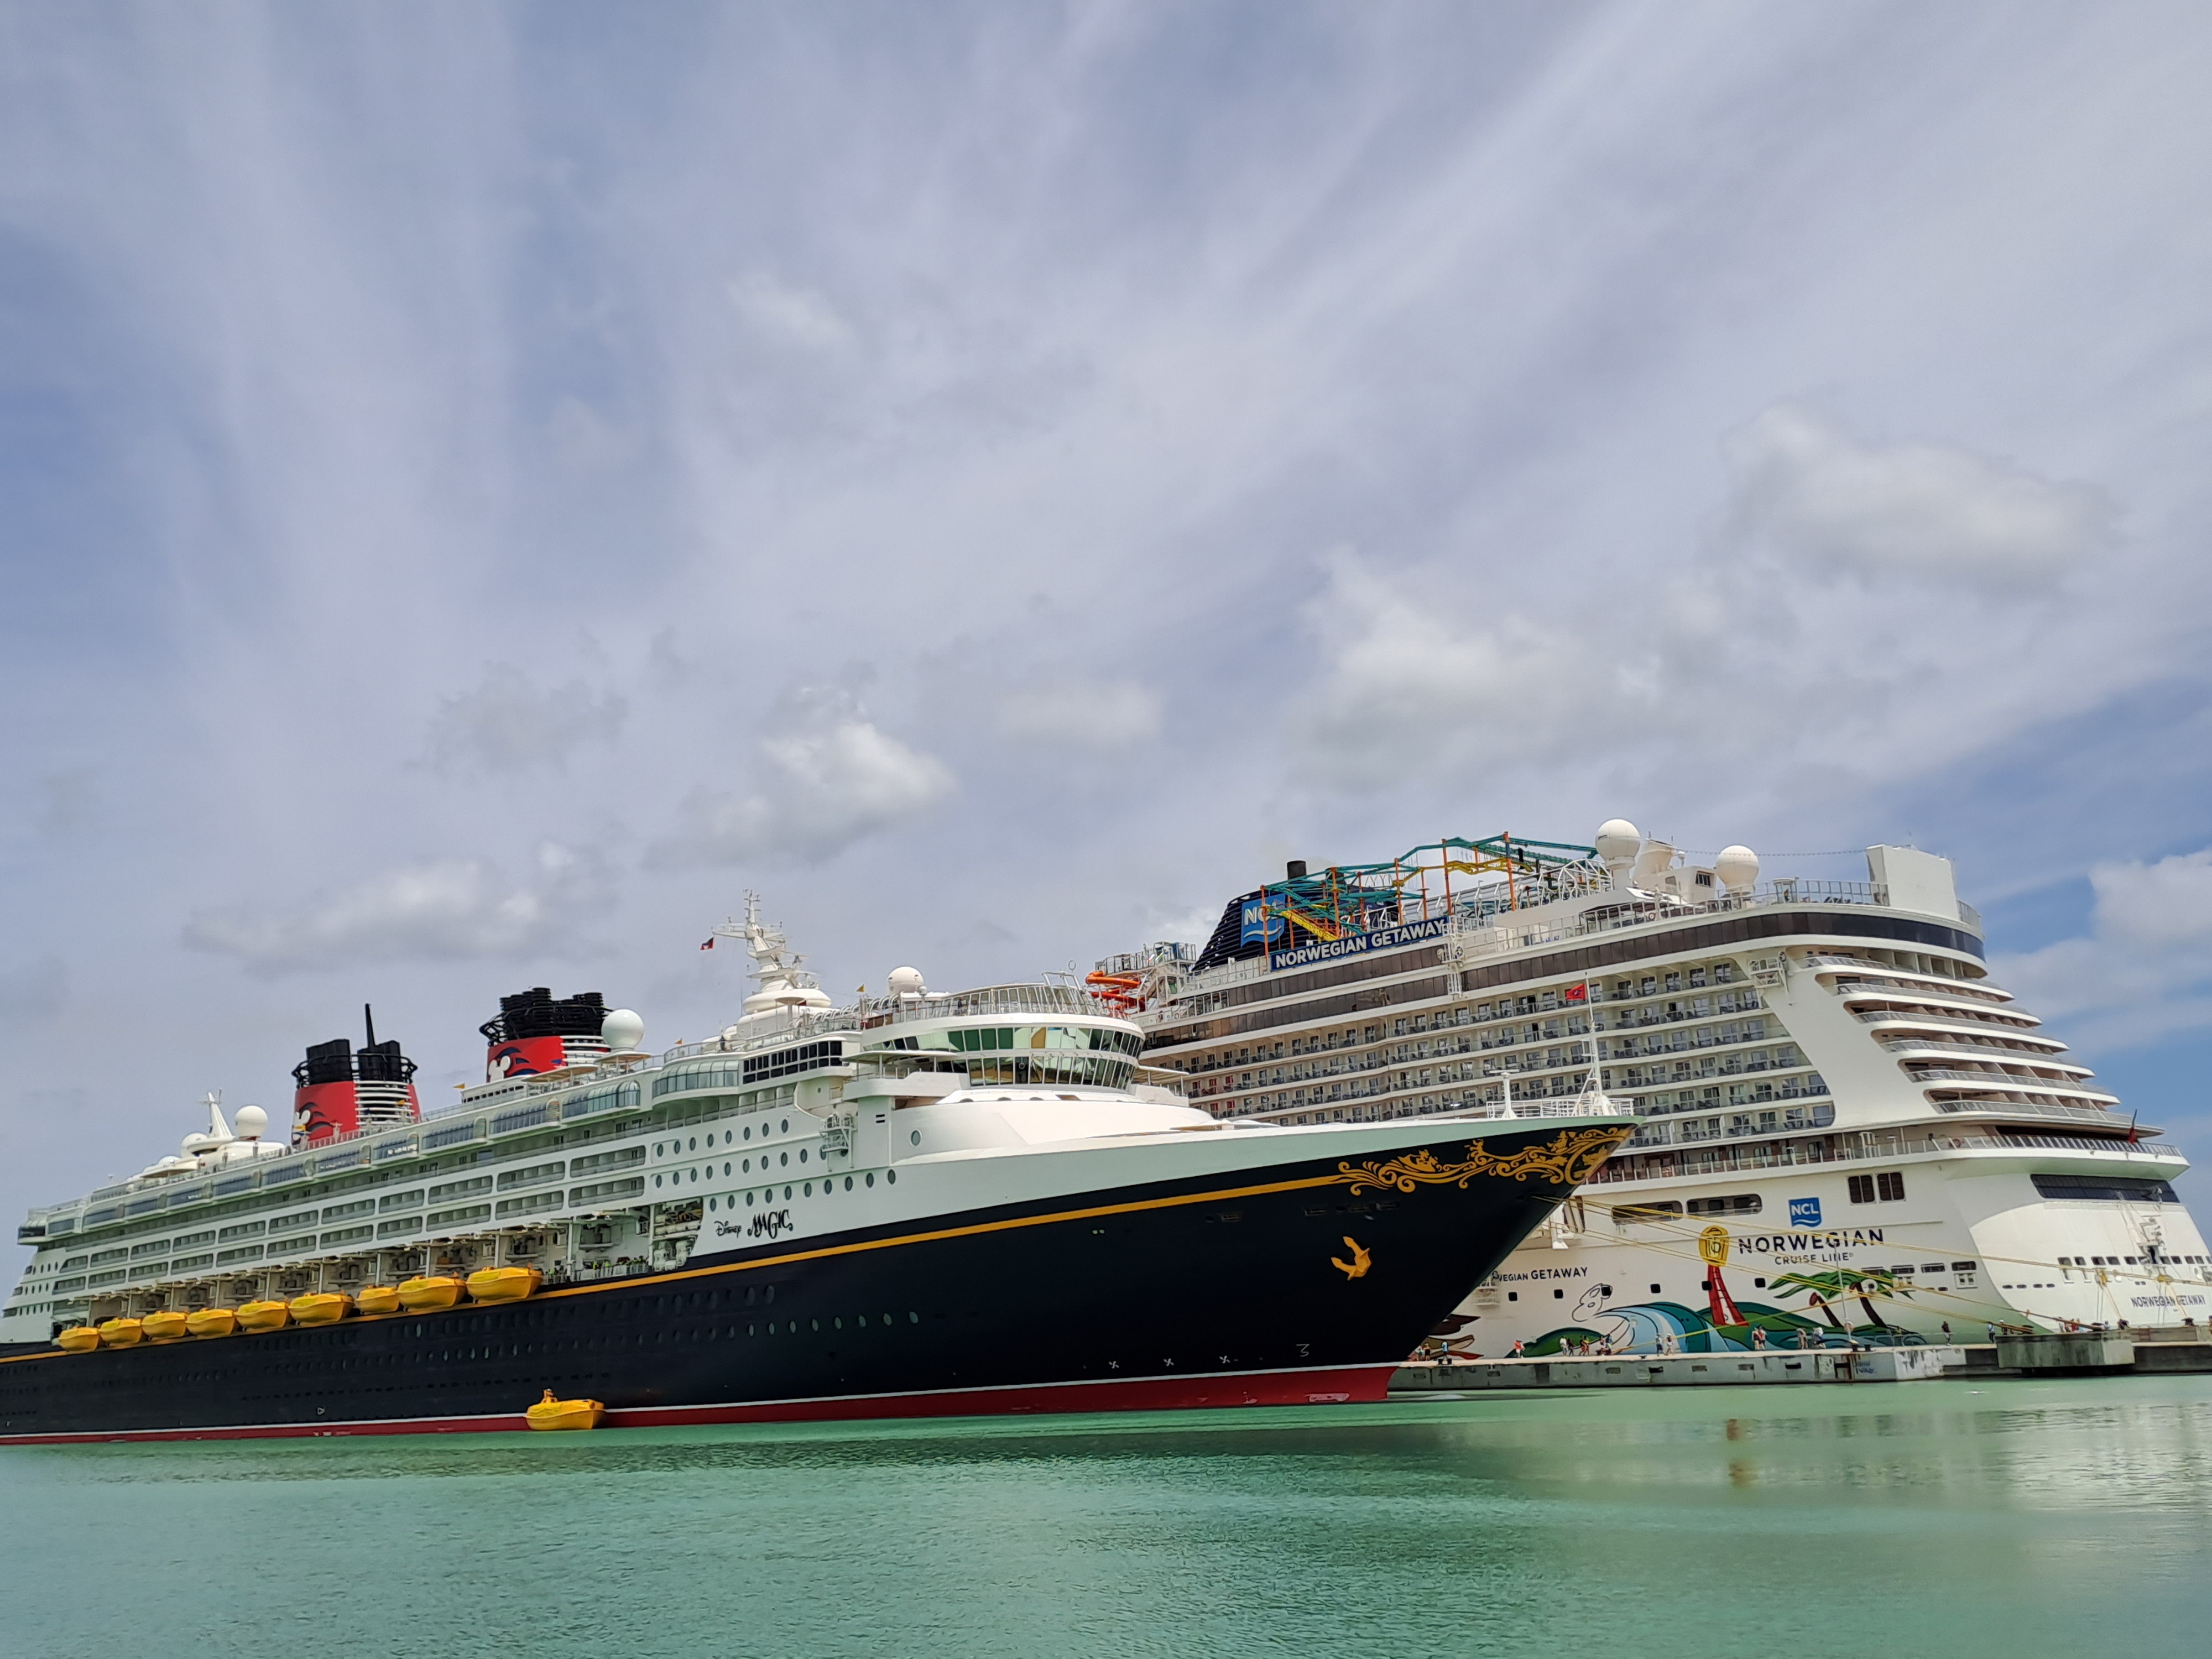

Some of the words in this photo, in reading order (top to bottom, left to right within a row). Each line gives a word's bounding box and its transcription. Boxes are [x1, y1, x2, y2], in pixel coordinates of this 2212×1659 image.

[1276, 936, 1366, 968] NORWEGIAN
[1371, 919, 1444, 947] GETAWAY
[1791, 1203, 1819, 1215] NCL
[1738, 1229, 1884, 1254] NORWEGIAN
[1775, 1254, 1816, 1265] CRUISE
[1531, 1266, 1587, 1279] GETAWAY
[2130, 1295, 2176, 1307] NORWEGIAN
